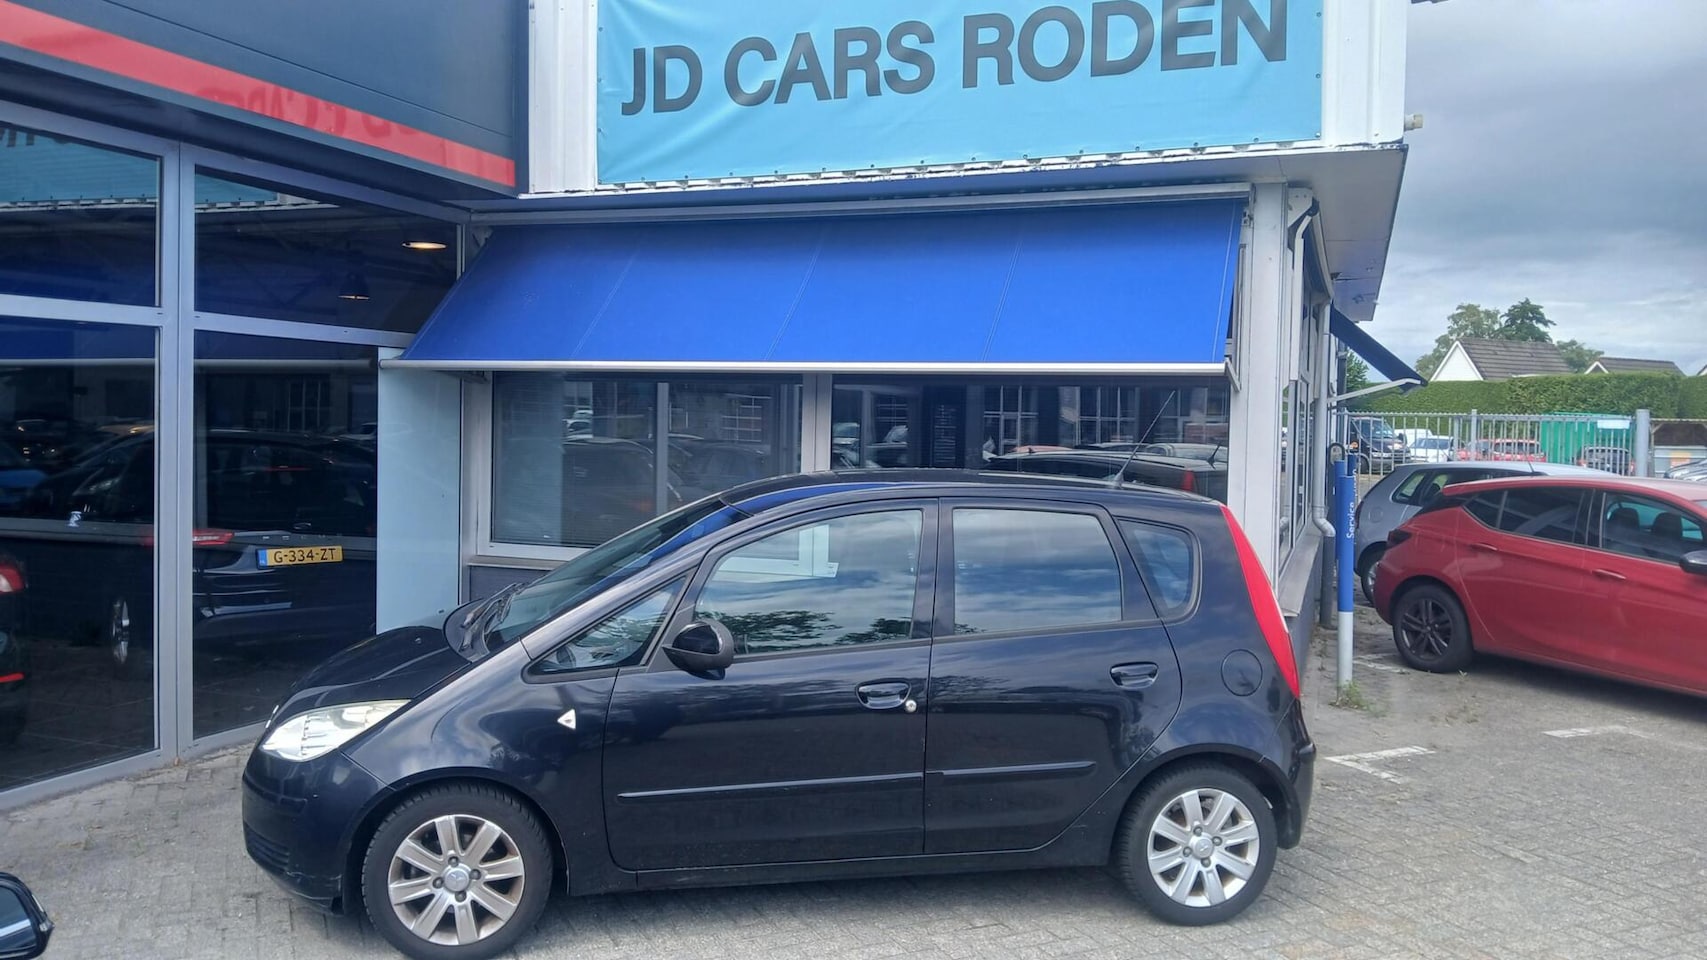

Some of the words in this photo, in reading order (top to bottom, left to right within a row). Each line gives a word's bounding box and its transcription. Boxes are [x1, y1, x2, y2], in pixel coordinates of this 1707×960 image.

[621, 45, 703, 116] JD
[724, 20, 935, 107] CARS
[962, 0, 1287, 88] RODEN
[1346, 502, 1355, 539] Service
[273, 548, 336, 563] G-334-ZT
